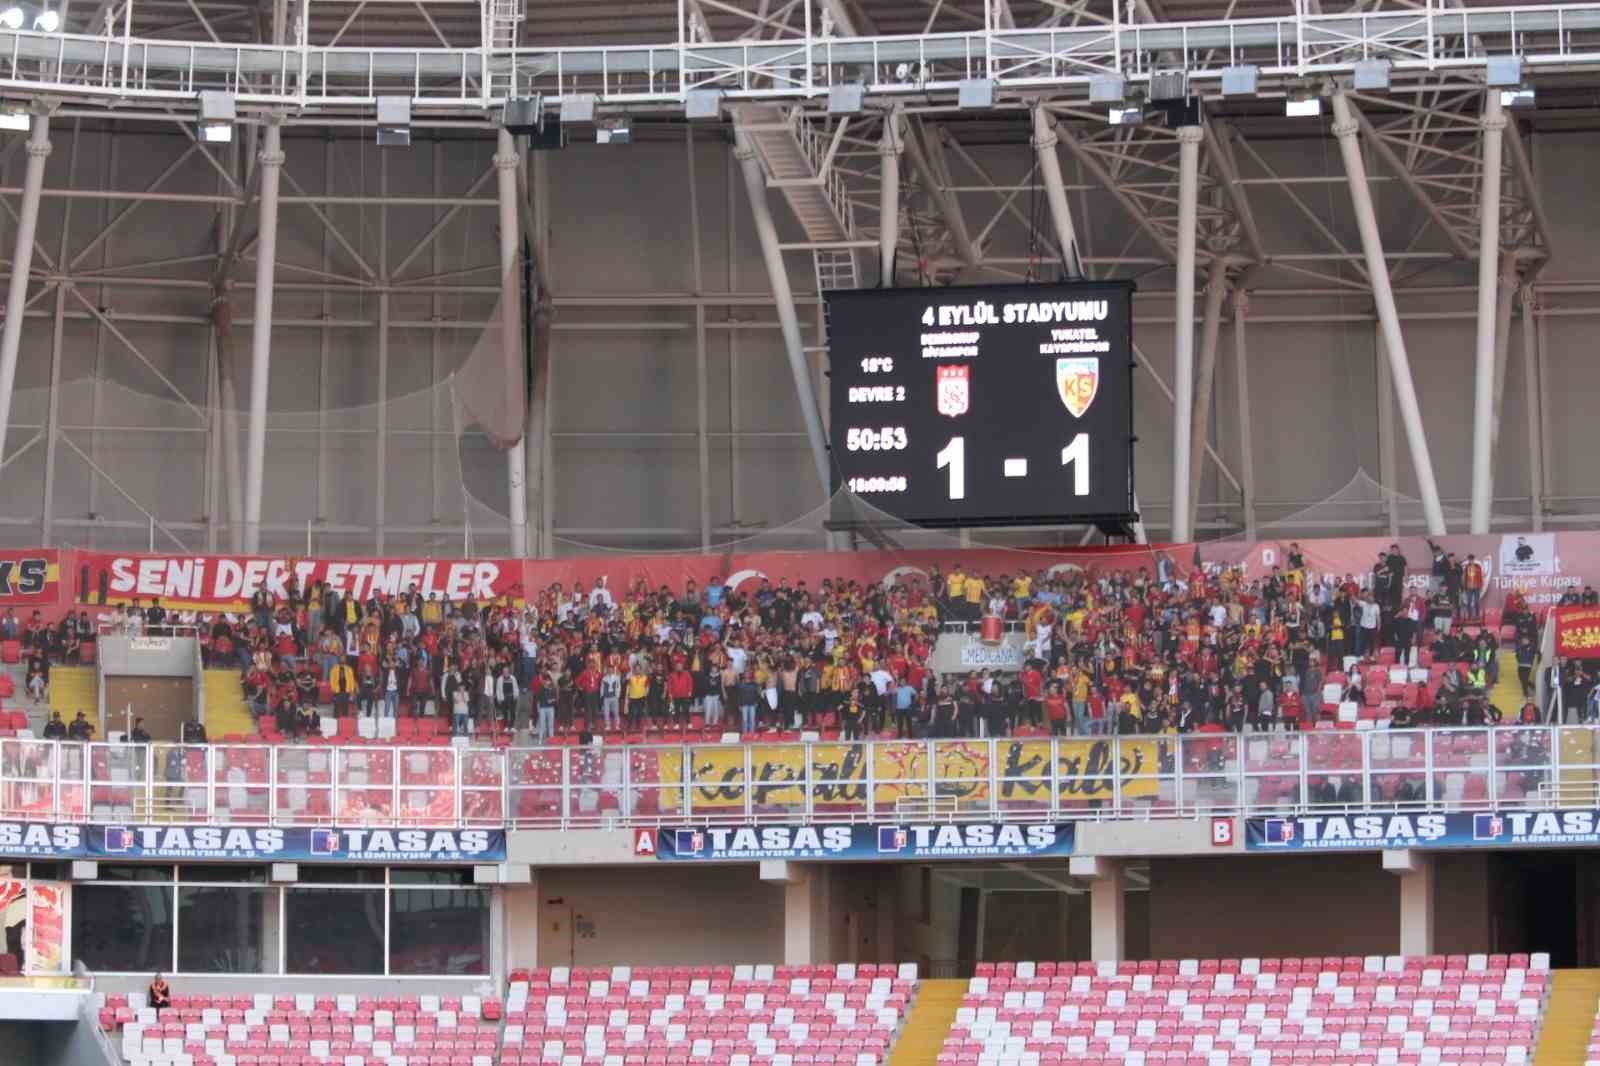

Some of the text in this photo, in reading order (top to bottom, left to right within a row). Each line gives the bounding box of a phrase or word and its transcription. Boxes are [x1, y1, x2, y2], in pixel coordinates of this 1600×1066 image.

[922, 300, 1108, 326] 4 EYLÜL STADYUMU
[849, 386, 905, 402] DEVRE 2
[847, 427, 907, 451] 50:53
[937, 436, 964, 499] 1
[1061, 433, 1089, 496] 1
[213, 560, 316, 601] DERT
[325, 561, 499, 601] ETMELER
[636, 831, 654, 852] A
[1213, 821, 1231, 843] B
